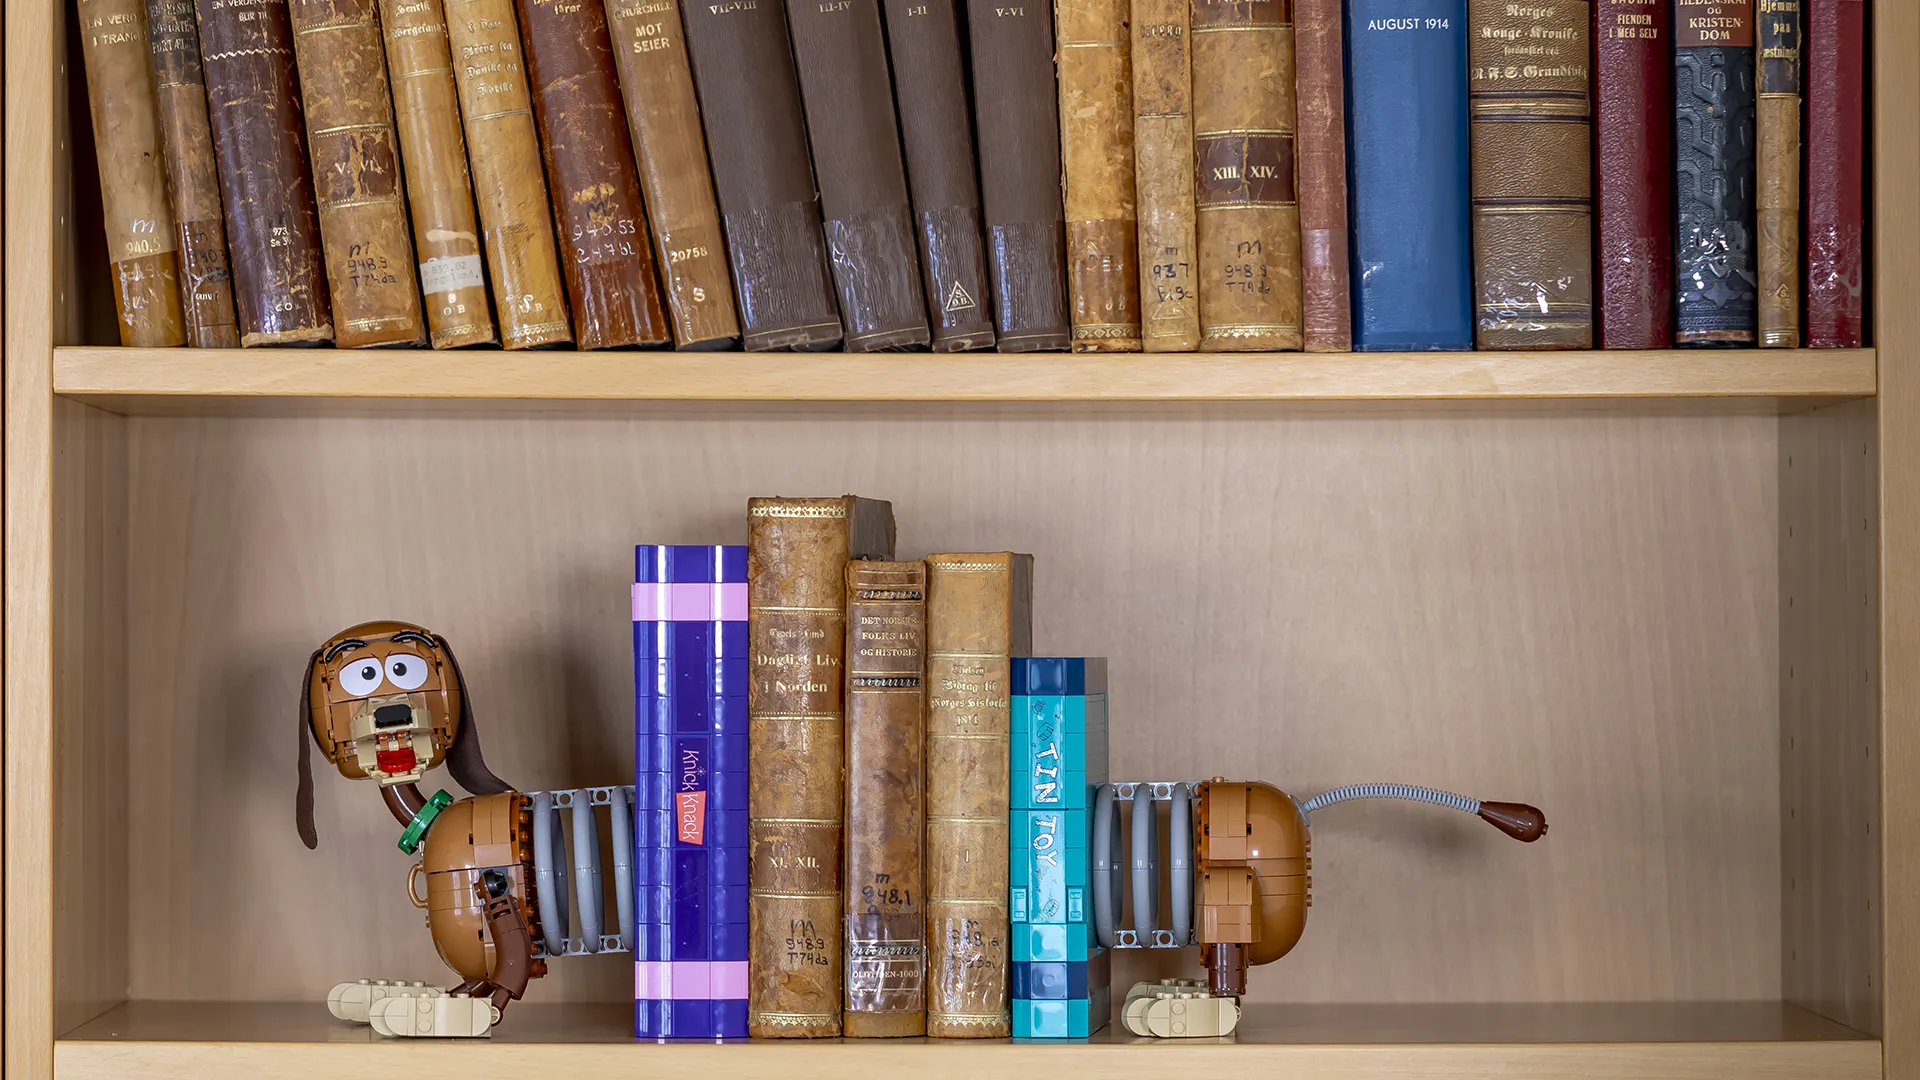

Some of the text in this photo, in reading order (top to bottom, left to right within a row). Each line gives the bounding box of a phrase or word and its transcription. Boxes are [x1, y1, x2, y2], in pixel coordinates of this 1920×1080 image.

[908, 6, 927, 17] I-II
[995, 7, 1024, 17] V-VI
[1707, 7, 1722, 15] OG
[1368, 18, 1449, 31] AUGUST 1914
[1617, 14, 1652, 25] FIENDEN
[1689, 17, 1744, 29] KRISTEN-
[635, 23, 662, 37] MOT
[1617, 28, 1636, 38] MEG
[1639, 27, 1658, 39] SELV
[1700, 30, 1731, 41] DOM
[1773, 22, 1791, 36] paa
[633, 38, 671, 53] SEIER
[1213, 165, 1279, 181] XIII. XIV.
[572, 219, 636, 242] 940.53
[1153, 263, 1189, 279] 937
[861, 616, 881, 625] DET
[862, 632, 916, 640] FOLKS LIV
[860, 648, 918, 657] OG HISTORIE
[816, 654, 838, 667] Liv
[775, 680, 828, 693] Norden
[681, 748, 700, 792] Knick
[1035, 742, 1060, 804] TIN
[681, 793, 700, 841] Knack
[1032, 815, 1060, 867] TOY
[795, 856, 820, 869] XII.
[875, 873, 891, 884] m
[785, 938, 825, 951] 948.9
[787, 952, 829, 966] T74da
